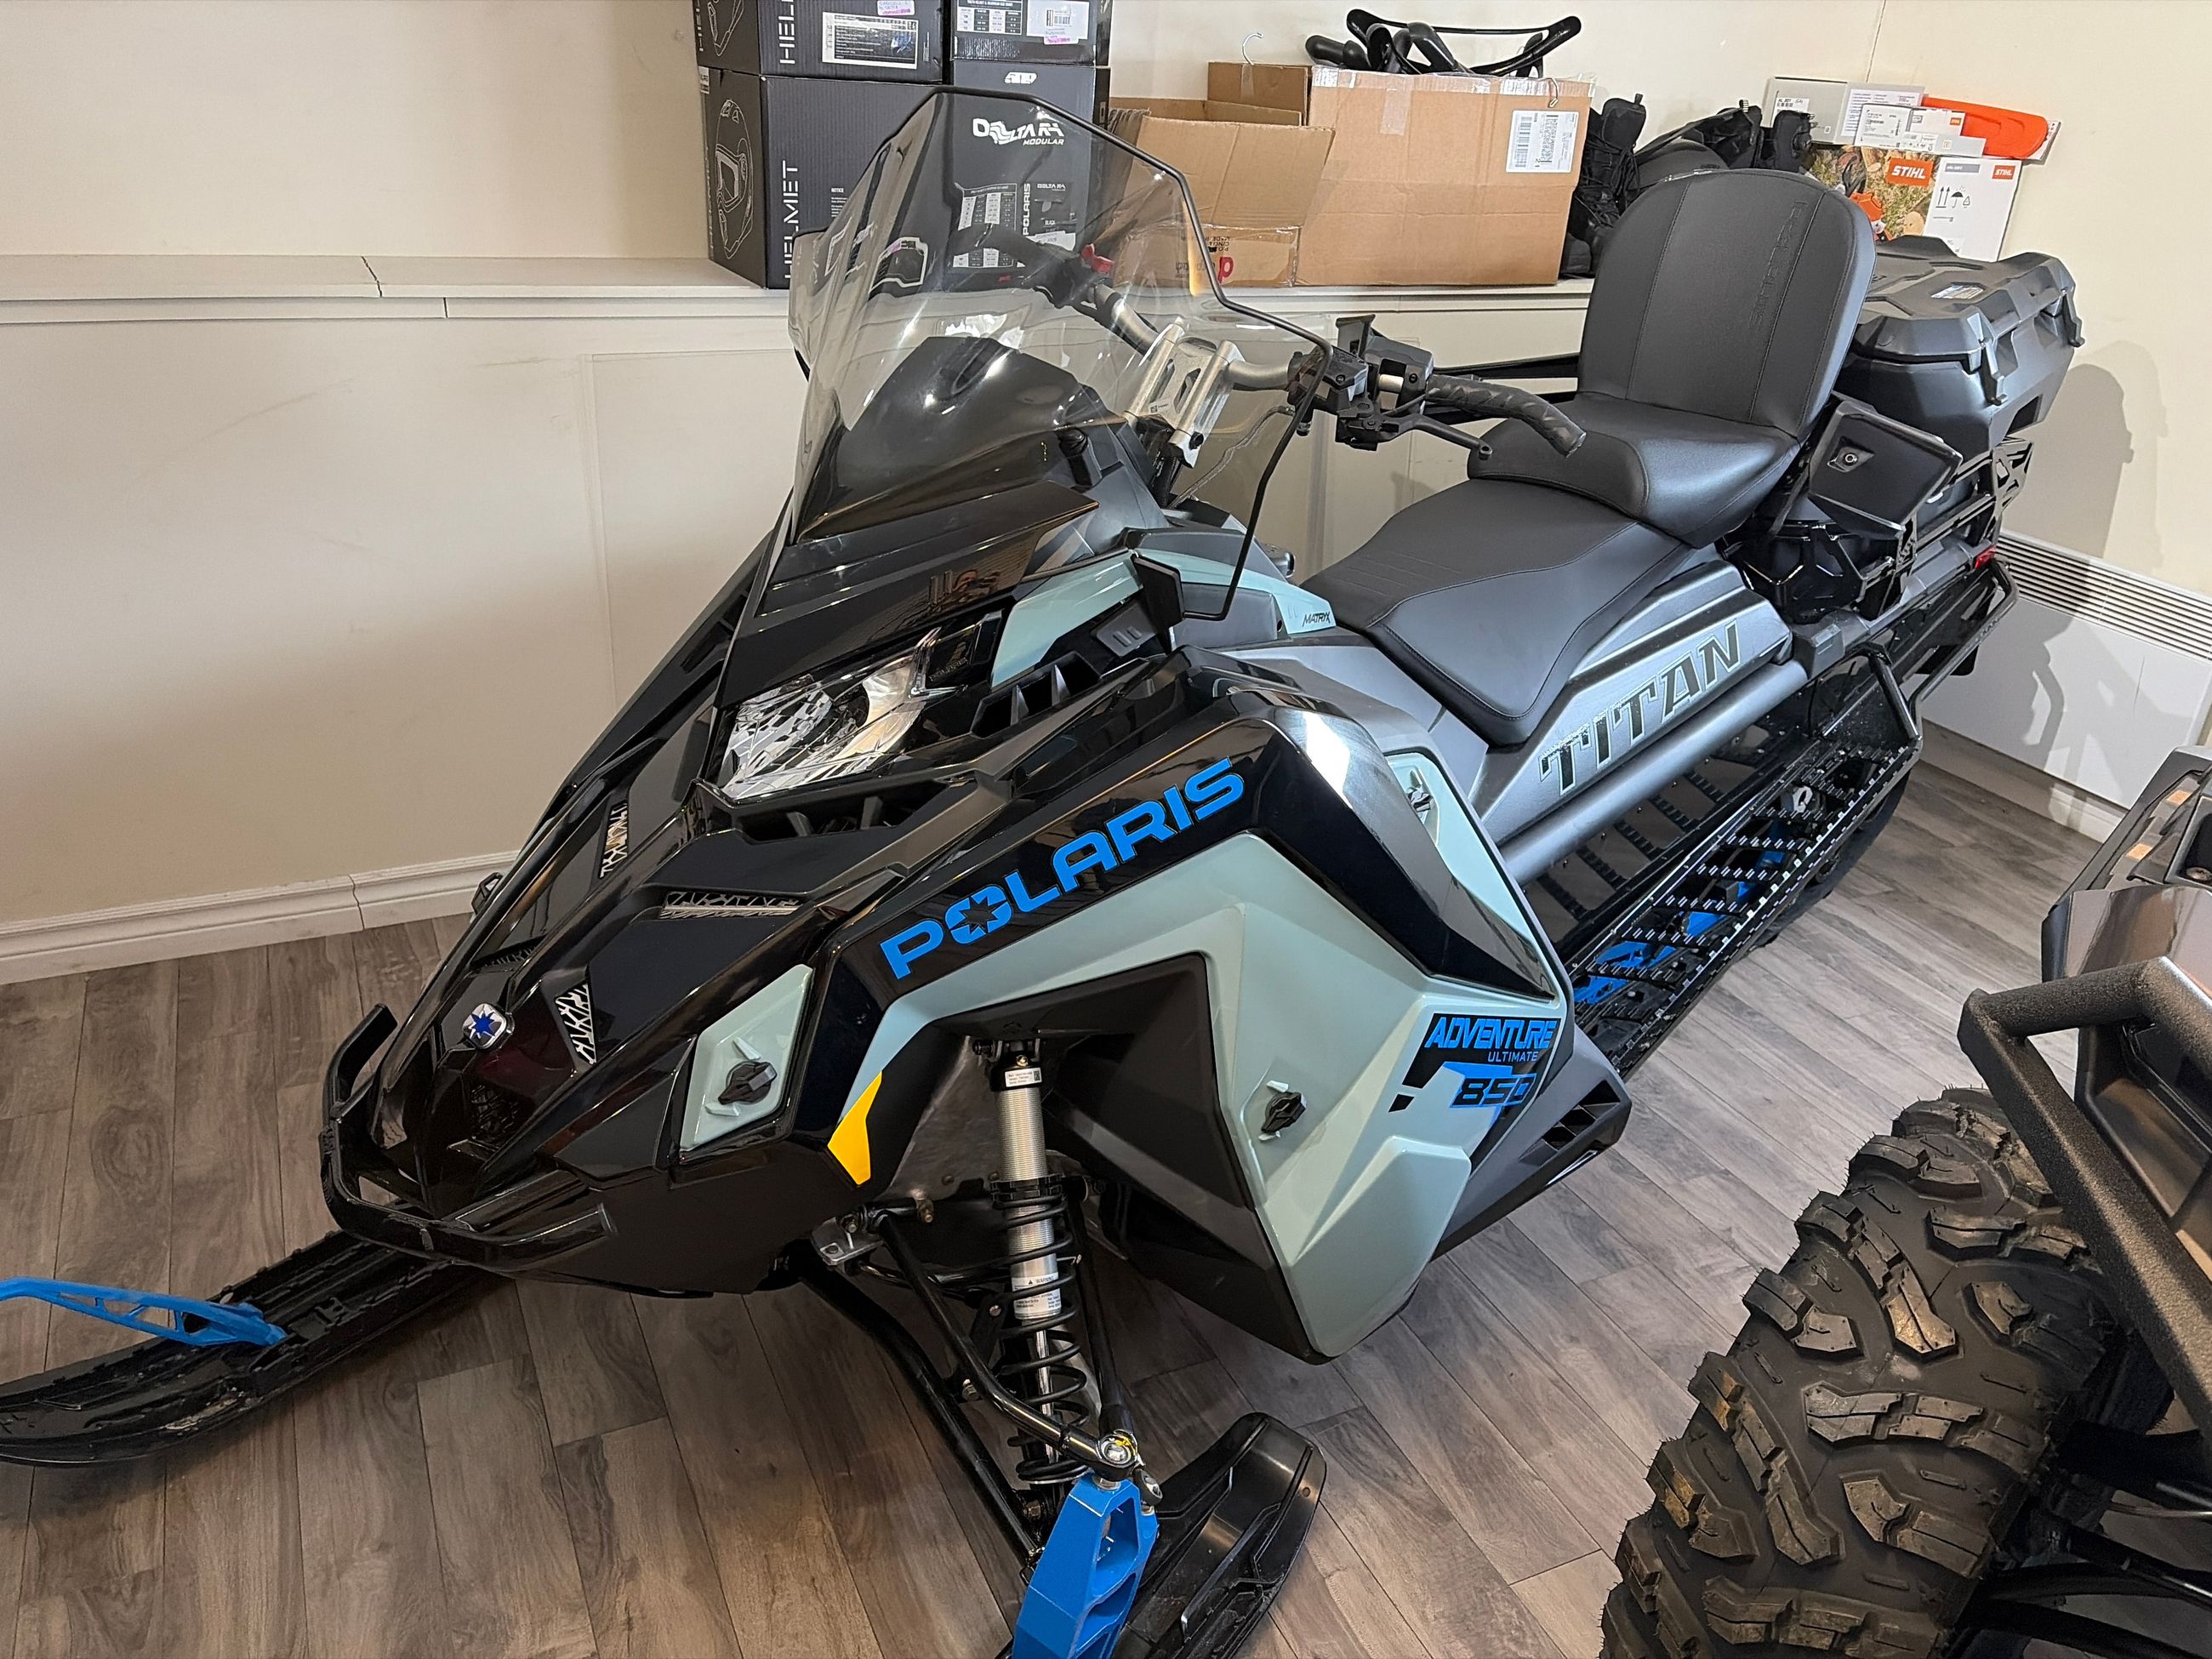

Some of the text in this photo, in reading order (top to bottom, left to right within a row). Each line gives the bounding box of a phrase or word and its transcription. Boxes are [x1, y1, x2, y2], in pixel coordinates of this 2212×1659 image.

[778, 0, 795, 65] HEL
[1022, 138, 1065, 146] MODULAR
[1890, 165, 1927, 180] STIHL
[1994, 168, 2013, 177] STIHL
[1022, 183, 1031, 237] POLARIS
[1302, 611, 1331, 627] MATRYX
[1538, 618, 1742, 797] TITAN
[879, 755, 1246, 980] POLARIS
[1424, 1017, 1558, 1049] ADVENTURE
[1487, 1051, 1539, 1063] ULTIMATE
[1451, 1075, 1536, 1106] 850
